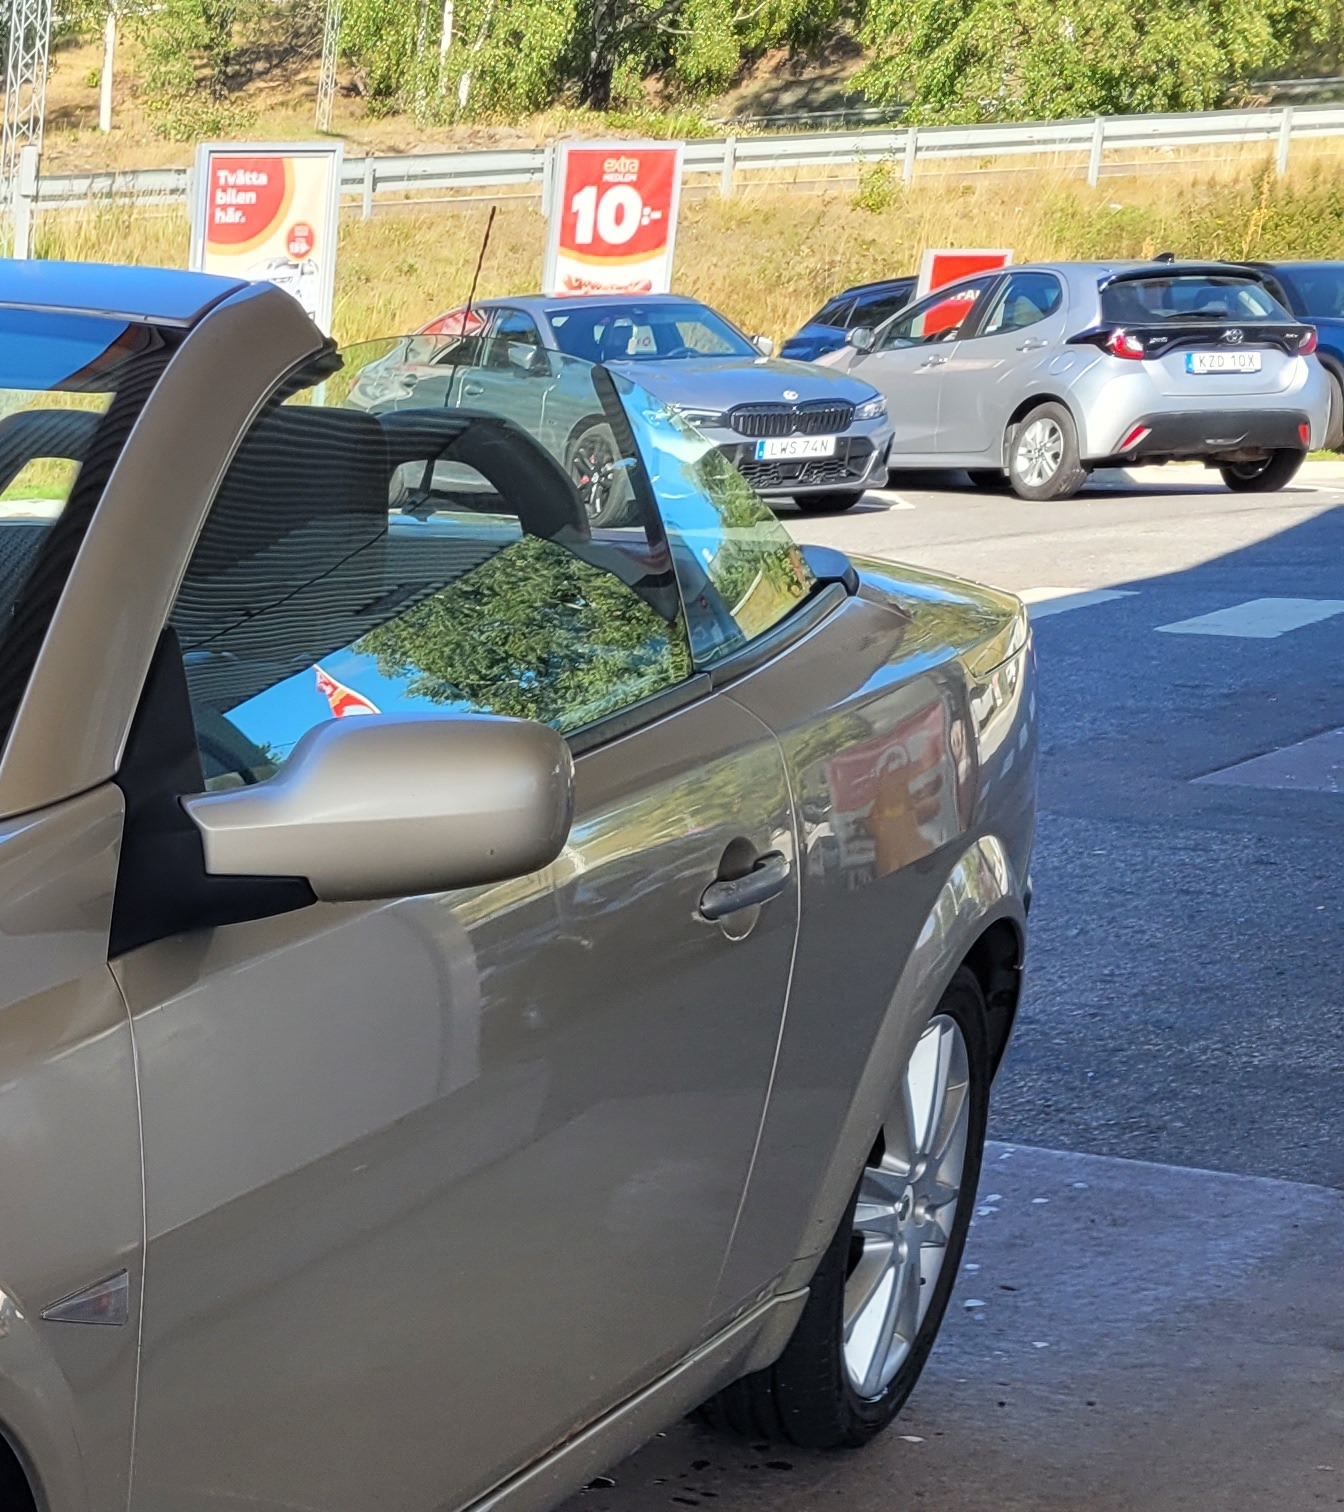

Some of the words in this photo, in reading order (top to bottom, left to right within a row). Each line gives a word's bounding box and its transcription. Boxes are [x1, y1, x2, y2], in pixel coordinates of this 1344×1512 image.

[603, 156, 640, 173] extra
[216, 168, 268, 186] Tvätta
[215, 188, 257, 205] bilen
[214, 207, 247, 224] här.
[571, 184, 663, 245] 10:-
[1199, 355, 1225, 368] KZD
[1232, 354, 1255, 367] 10X
[770, 441, 798, 455] LWS
[802, 440, 829, 454] 74N
